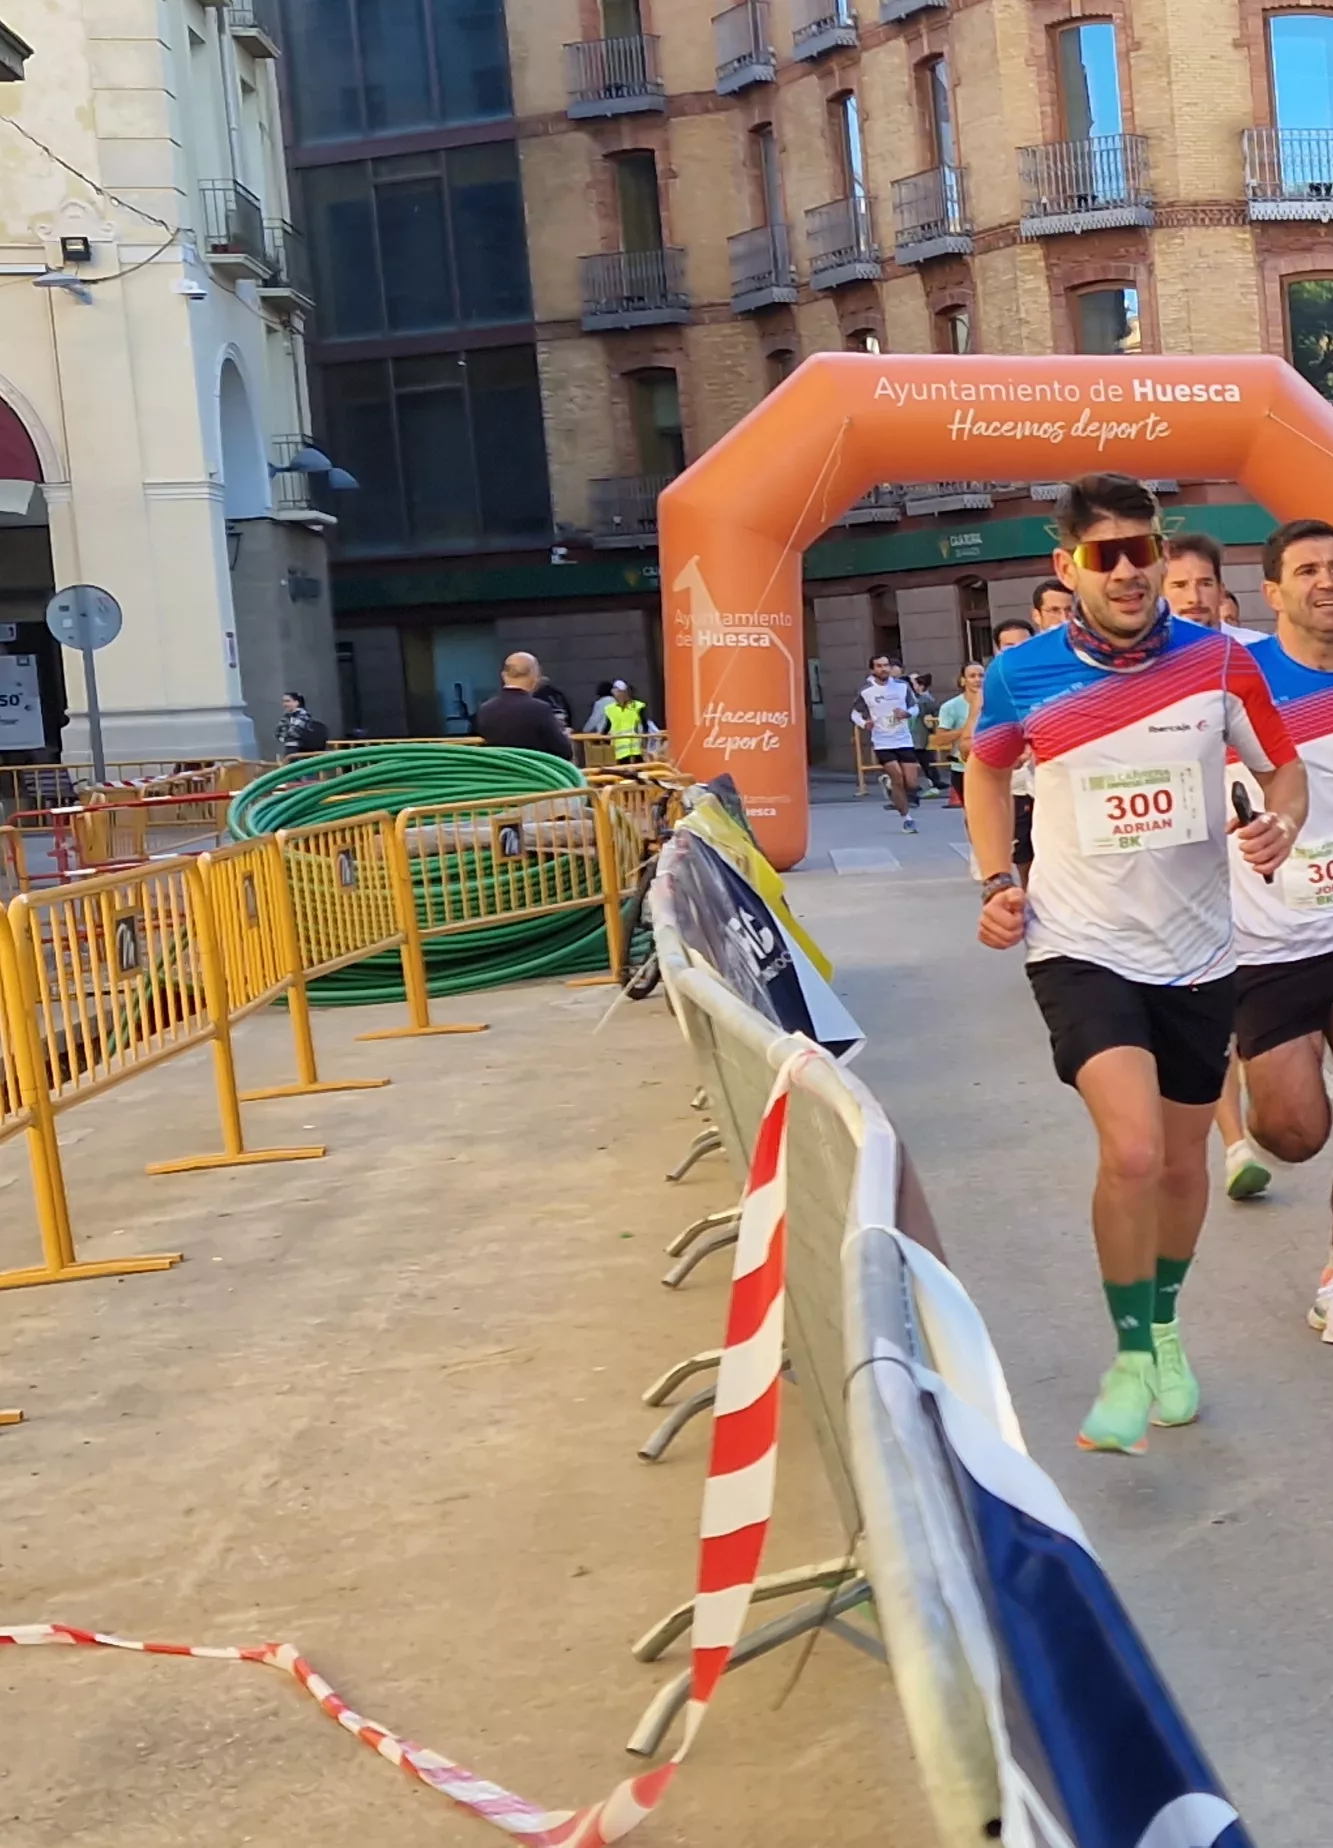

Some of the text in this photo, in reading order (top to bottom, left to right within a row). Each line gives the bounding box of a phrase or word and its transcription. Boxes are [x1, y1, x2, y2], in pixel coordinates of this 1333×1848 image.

[874, 376, 1241, 407] Ayuntamiento de Huesca
[948, 408, 1172, 451] Hacemos deporte
[674, 609, 792, 630] Ayuntamiento
[699, 629, 771, 648] Huesca
[703, 702, 788, 727] Hacemos
[703, 724, 780, 760] deporte
[1105, 789, 1173, 820] 300
[1112, 818, 1173, 835] ADRIAN
